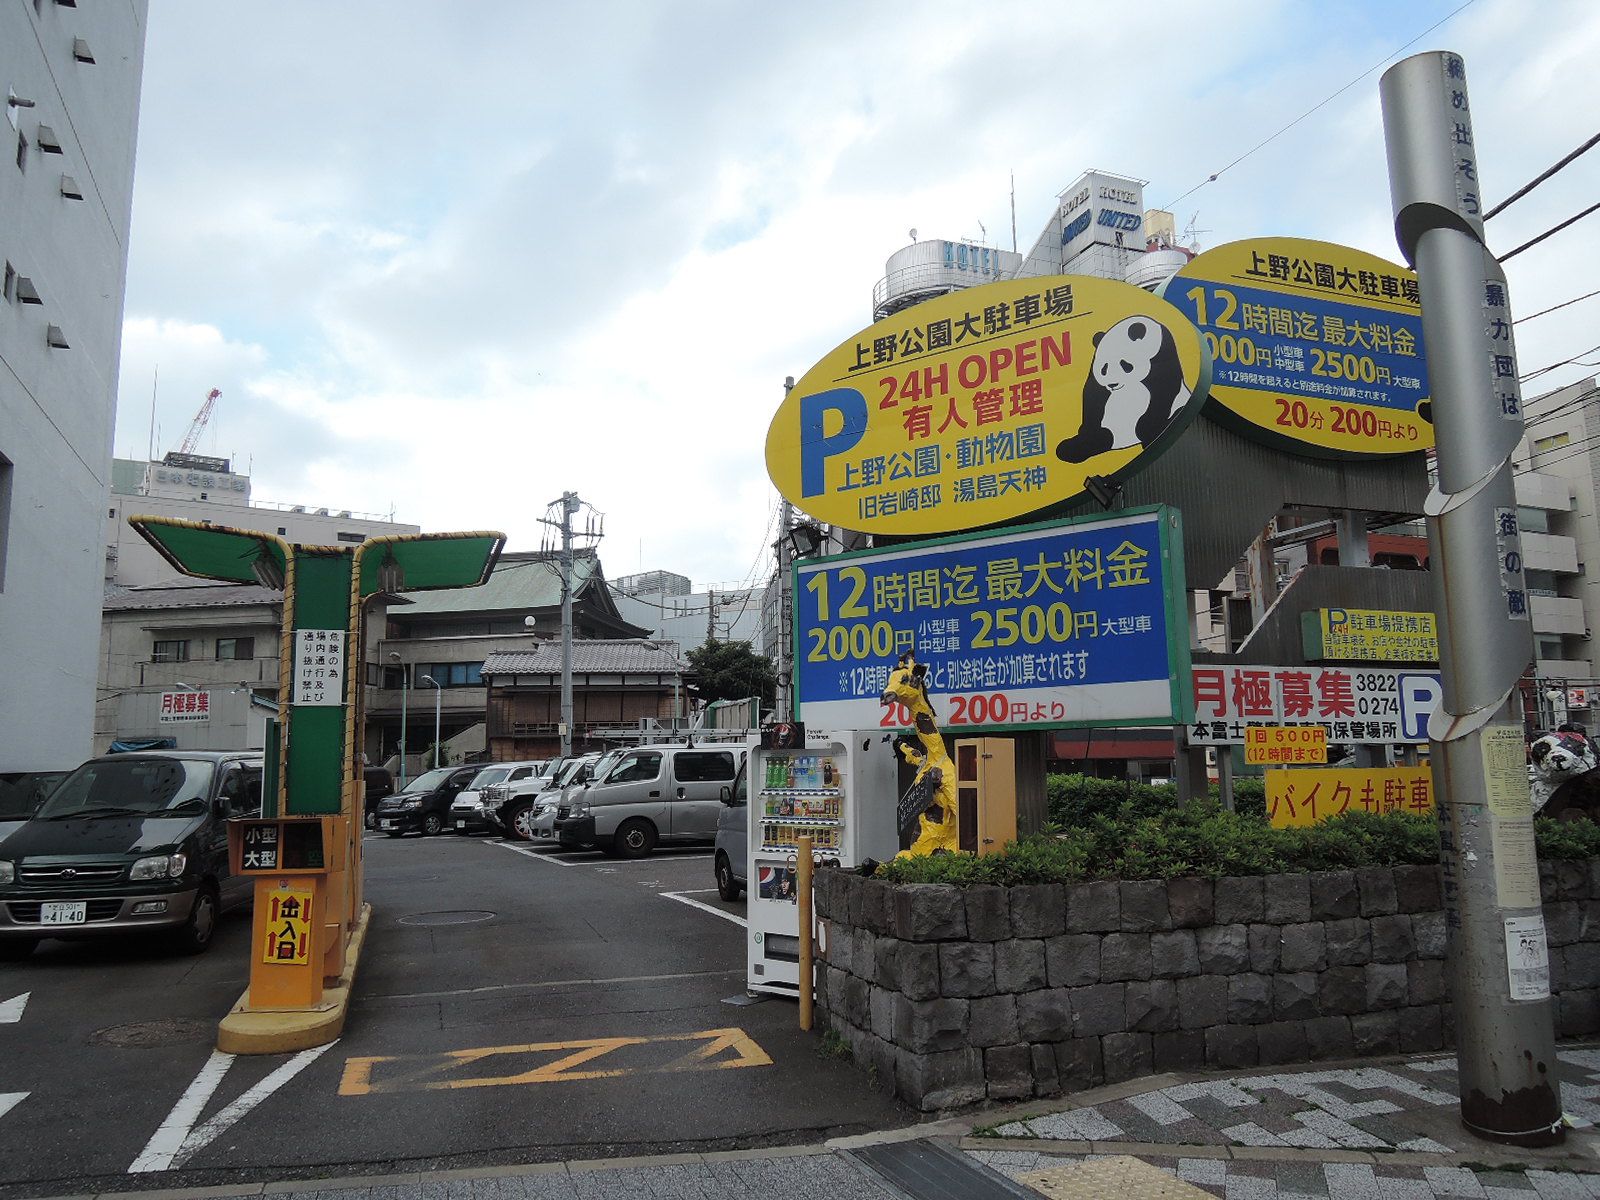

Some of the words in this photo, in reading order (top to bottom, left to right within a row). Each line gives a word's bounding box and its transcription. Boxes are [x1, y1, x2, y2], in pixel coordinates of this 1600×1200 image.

[1062, 187, 1091, 217] HOTEL
[1099, 186, 1138, 205] HOTEL
[1097, 208, 1142, 232] UNITED
[1246, 250, 1421, 305] 上野公園大駐車場
[848, 284, 1074, 373] 上野公園大駐車場
[1322, 314, 1418, 358] 最大料金
[1485, 284, 1519, 415] 暴力団は
[878, 362, 949, 411] 24H
[957, 331, 1073, 391] OPEN
[1203, 331, 1273, 369] 000円
[1310, 347, 1391, 386] 2500円
[1392, 375, 1421, 391] 大型車
[902, 378, 1045, 441] 有人管理
[1275, 398, 1325, 430] 20分
[1330, 406, 1418, 441] 200円より
[800, 386, 869, 499] P
[836, 422, 1047, 492] 上野公園・動物園
[858, 483, 942, 520] 旧岩崎邸
[953, 465, 1048, 503] 湯島天神
[806, 563, 980, 622] 12時間迄
[986, 540, 1151, 602] 最大料金
[1500, 514, 1526, 616] 街の敵
[807, 620, 915, 663] 2000円
[918, 618, 960, 636] 小型車
[970, 602, 1099, 650] 2500円
[1101, 614, 1152, 636] 大型車
[1328, 608, 1348, 634] P
[1350, 613, 1431, 634] 駐車場提携店
[301, 631, 314, 702] 通り抜け禁止
[314, 631, 326, 702] 場内通行及び
[328, 632, 340, 679] 危険の為
[919, 636, 961, 654] 中型車
[161, 692, 209, 714] 月極募集
[1192, 667, 1357, 719] 月極募集
[1356, 673, 1397, 692] 3822
[947, 693, 1066, 728] 200円より
[1358, 697, 1400, 716] 0274
[1402, 675, 1444, 738] P
[1246, 729, 1268, 743] 1回
[1276, 728, 1326, 743] 500円
[1247, 746, 1325, 762] (12時間まで)
[1269, 776, 1431, 820] バイクも駐車
[244, 850, 277, 867] 大型
[245, 827, 277, 844] 小型
[276, 895, 301, 960] 出入口
